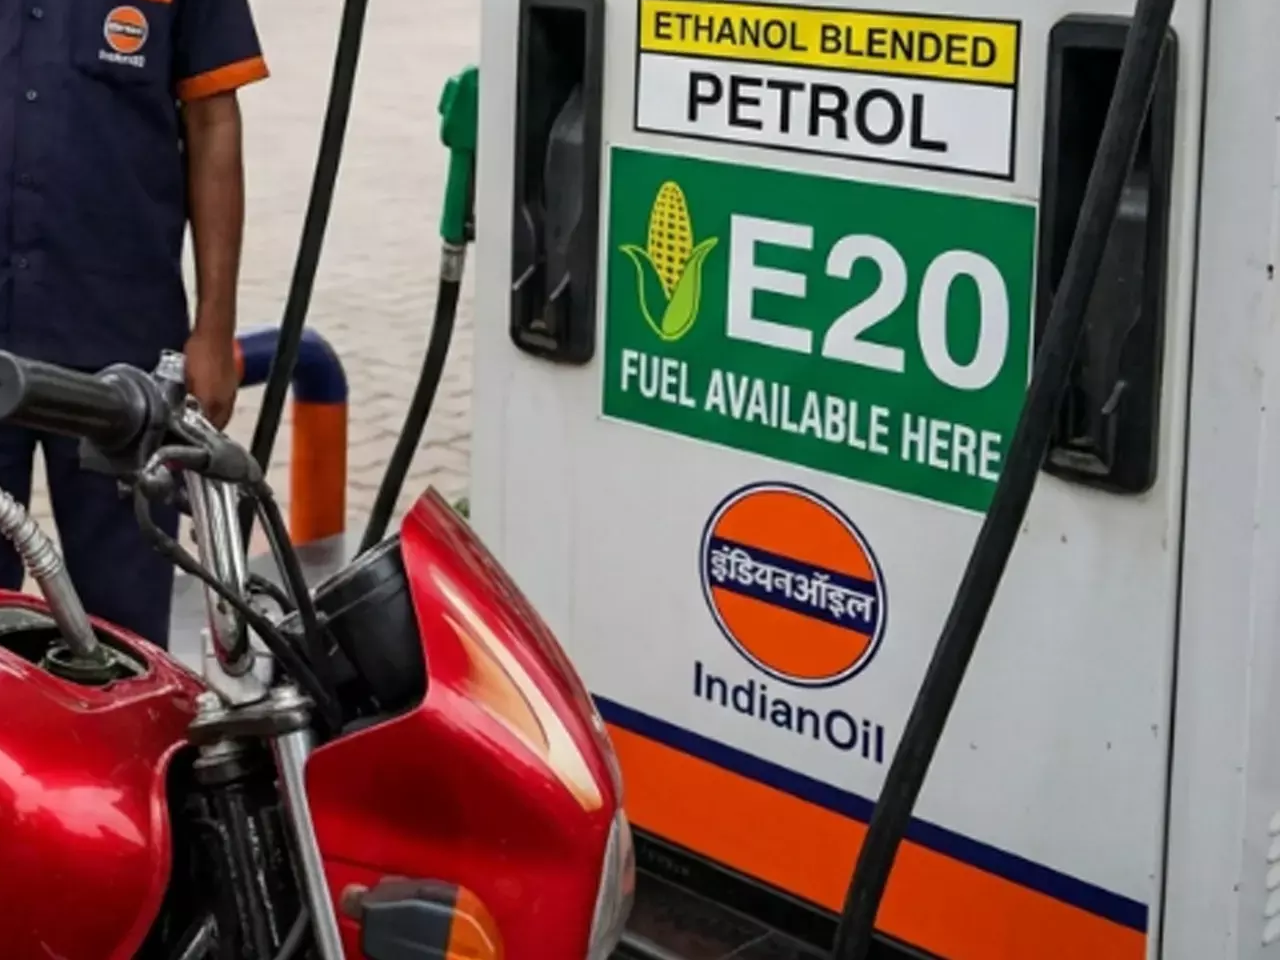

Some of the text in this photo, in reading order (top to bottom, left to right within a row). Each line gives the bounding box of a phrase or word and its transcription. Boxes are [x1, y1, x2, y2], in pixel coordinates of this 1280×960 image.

[654, 10, 997, 68] ETHANOL BLENDED
[687, 70, 948, 153] PETROL
[726, 213, 1010, 390] E20
[620, 348, 1003, 483] FUEL AVAILABLE HERE
[693, 660, 885, 764] IndianOil
